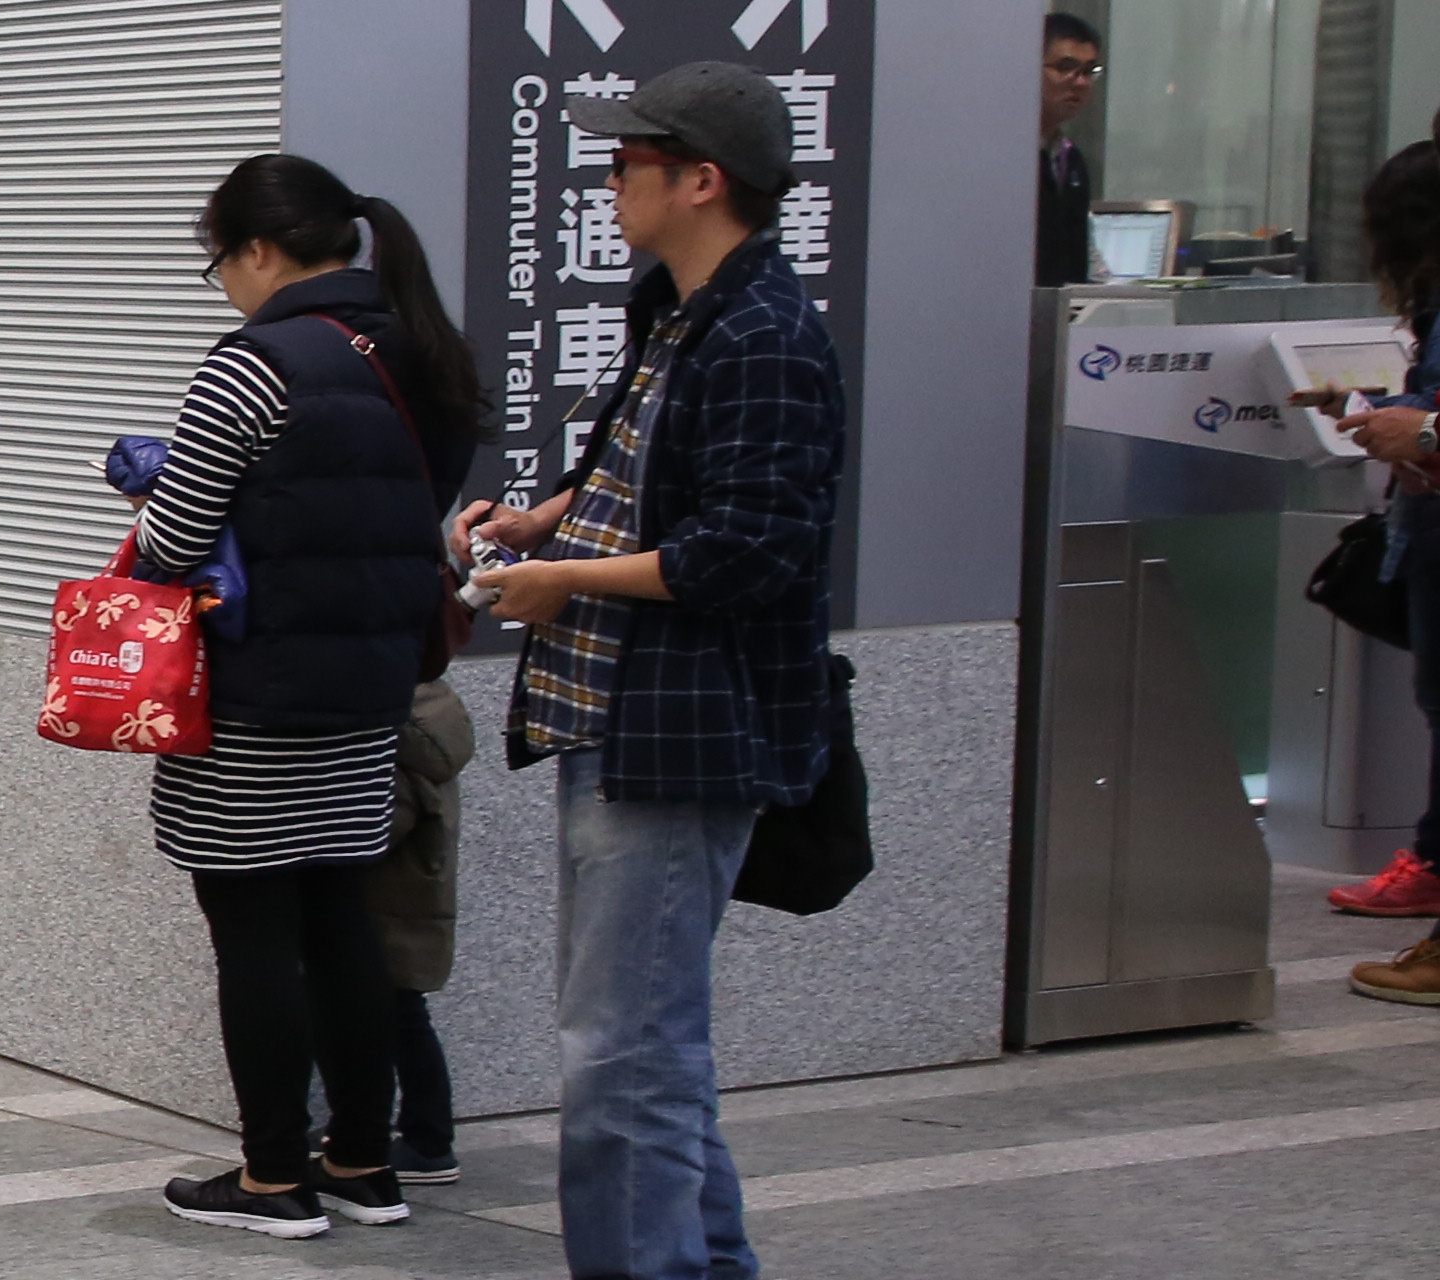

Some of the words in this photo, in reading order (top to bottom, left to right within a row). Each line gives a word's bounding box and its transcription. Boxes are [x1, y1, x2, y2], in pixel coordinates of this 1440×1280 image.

[508, 74, 549, 308] Commuter
[505, 322, 543, 435] Train
[69, 649, 118, 668] ChiaTe
